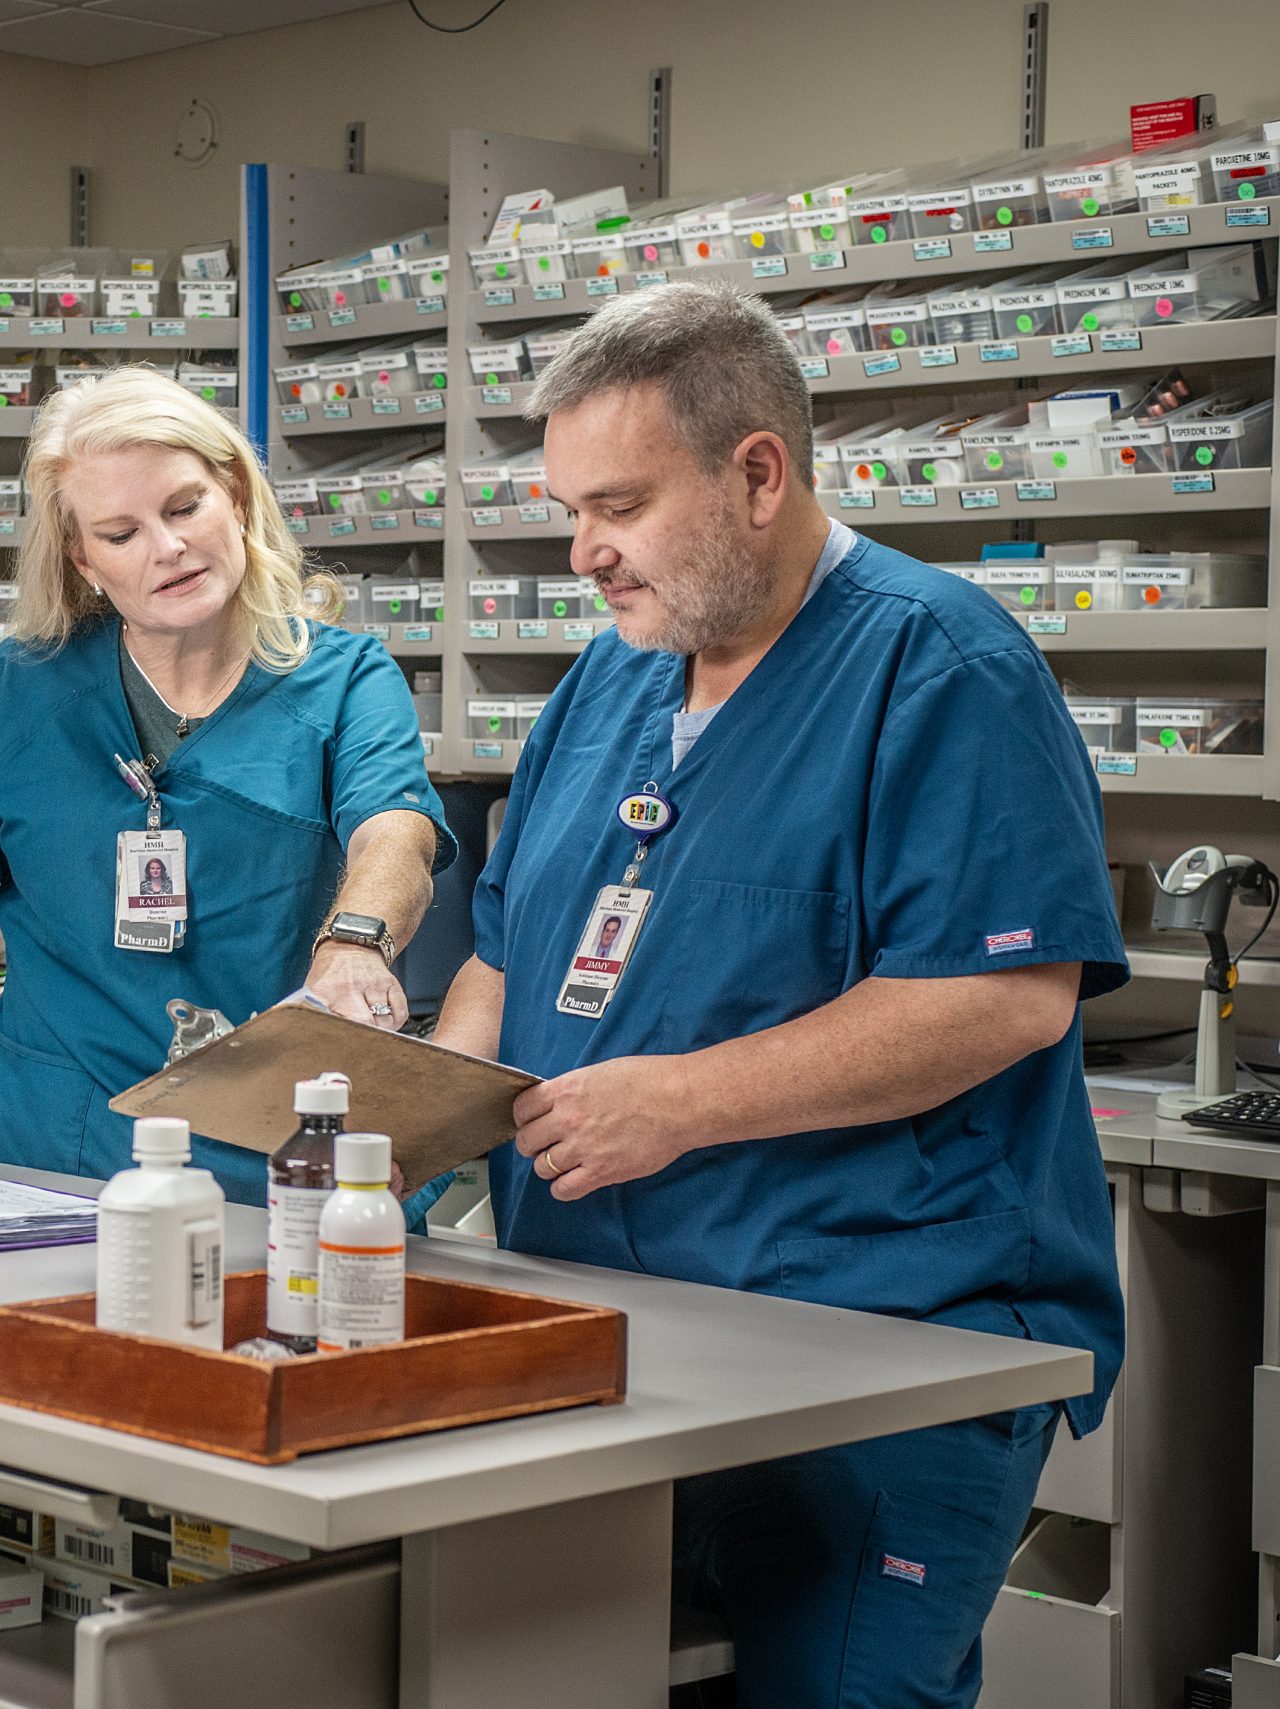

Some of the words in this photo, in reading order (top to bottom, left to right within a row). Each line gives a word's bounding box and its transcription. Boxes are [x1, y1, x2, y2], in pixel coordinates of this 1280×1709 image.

[1216, 154, 1253, 166] PAROXETINE
[1254, 152, 1270, 162] 10MG
[1087, 173, 1103, 183] 40MG
[1136, 168, 1179, 180] PANTOPRAZOLE
[1180, 166, 1196, 175] 40MG
[1153, 181, 1178, 189] PACKETS
[978, 186, 1011, 197] OXYBUTYNIN
[1134, 282, 1167, 292] PREDNISONE
[1168, 280, 1184, 289] 10MG
[1064, 288, 1097, 298] PREDNISONE
[1098, 288, 1110, 296] 5MG
[1172, 426, 1208, 438] RISPERIDONE
[1209, 426, 1231, 435] 0.25MG
[1056, 570, 1096, 579] SULFASALAZINE
[1098, 570, 1118, 578] 500MG
[1125, 572, 1163, 580] SUMATRIPTAN
[1164, 572, 1181, 580] 25MG
[1138, 713, 1174, 721] VENLAFAXINE
[1175, 713, 1190, 721] 75MG
[139, 898, 175, 906] RACHEL
[613, 900, 629, 908] HMH
[121, 934, 168, 947] PharmD
[585, 960, 610, 971] JIMMY
[564, 996, 599, 1012] PharmD
